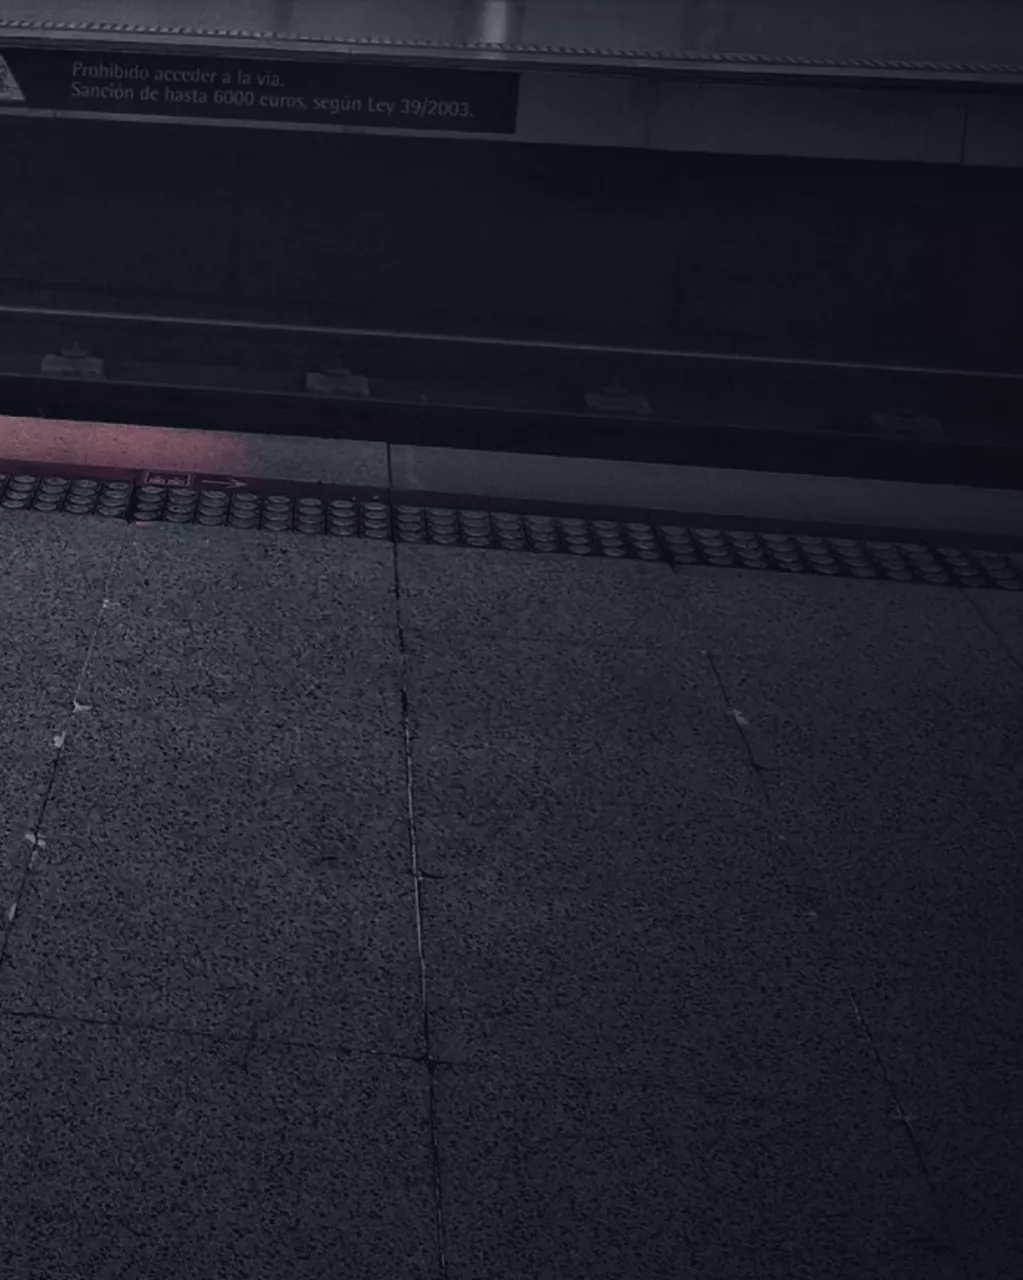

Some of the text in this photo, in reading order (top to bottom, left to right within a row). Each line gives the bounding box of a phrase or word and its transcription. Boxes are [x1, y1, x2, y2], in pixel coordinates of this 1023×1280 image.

[72, 61, 150, 81] Prohibido
[154, 66, 216, 84] acceder
[222, 72, 232, 84] a
[237, 67, 252, 85] la
[71, 80, 475, 119] Sanción de hasta 6000 euros, según Ley 39/2003.
